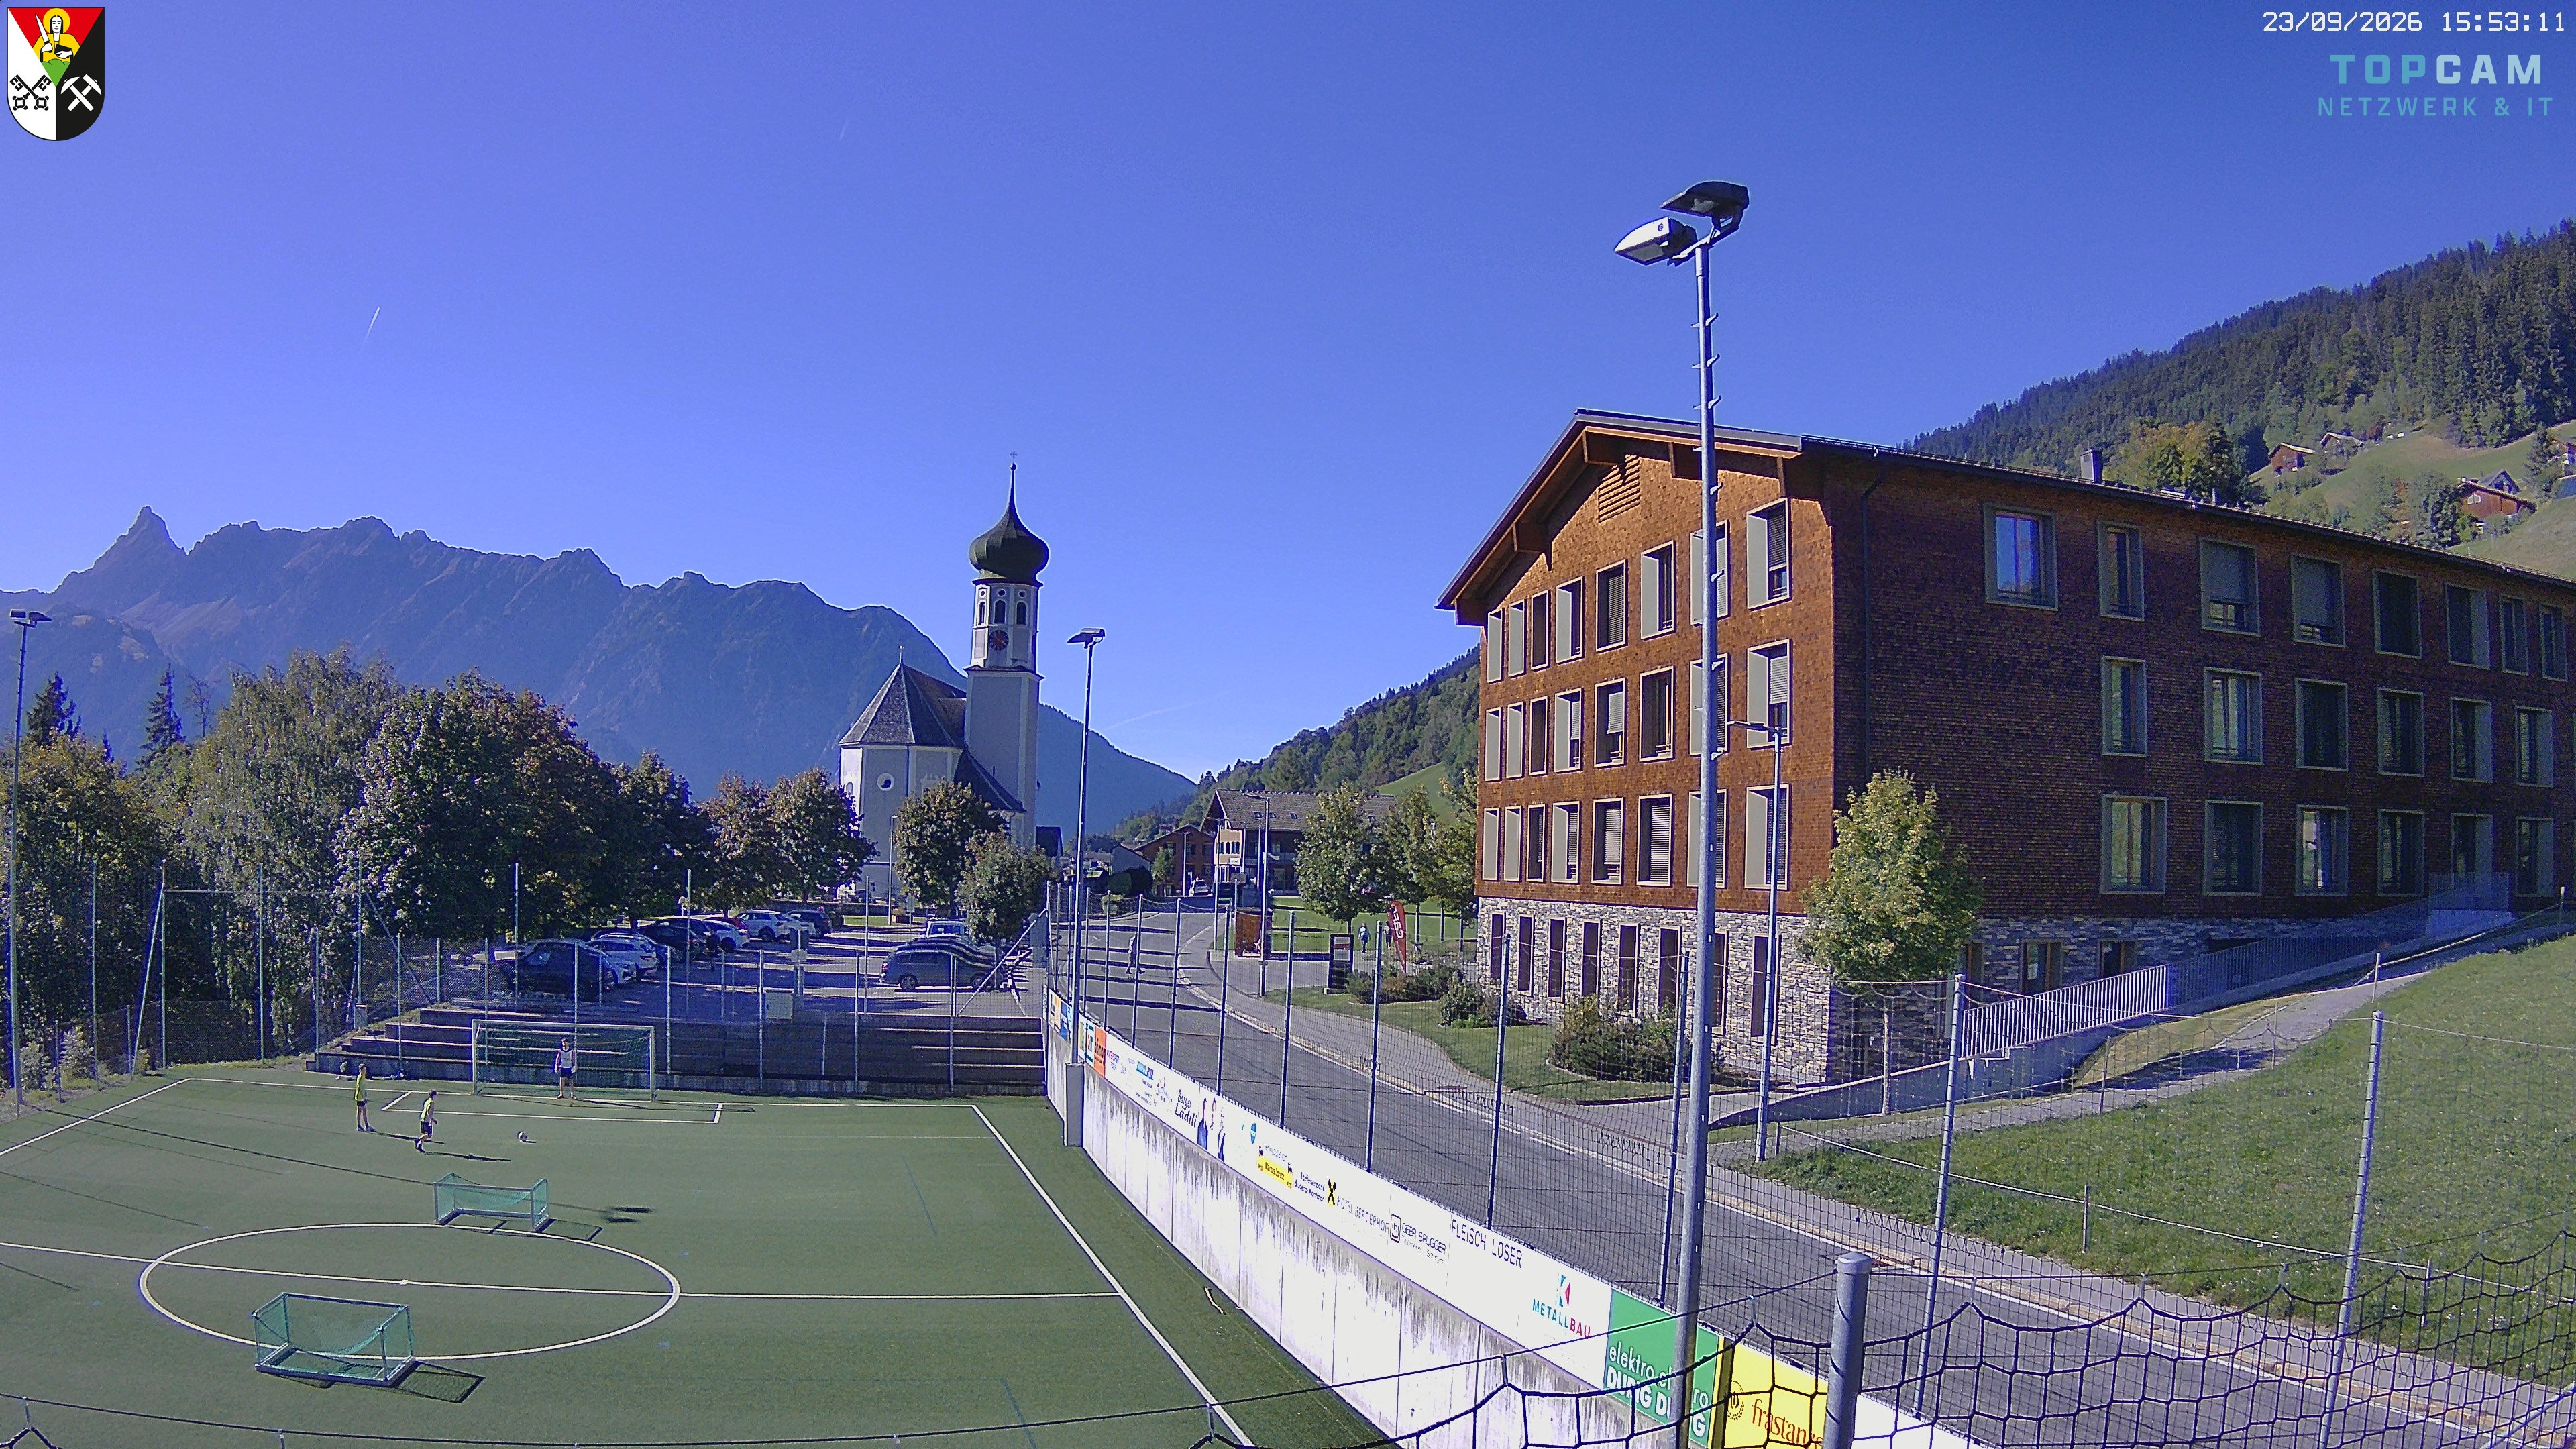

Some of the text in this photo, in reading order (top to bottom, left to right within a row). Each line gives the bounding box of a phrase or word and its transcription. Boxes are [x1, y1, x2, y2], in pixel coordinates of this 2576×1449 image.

[1337, 1195, 1354, 1215] HOTEL
[1355, 1205, 1389, 1235] BERGERHOF
[1451, 1219, 1487, 1250] FLEISCH
[1492, 1238, 1523, 1269] LOSER
[1532, 1298, 1591, 1339] METALLBAU
[1609, 1341, 1655, 1382] elektro
